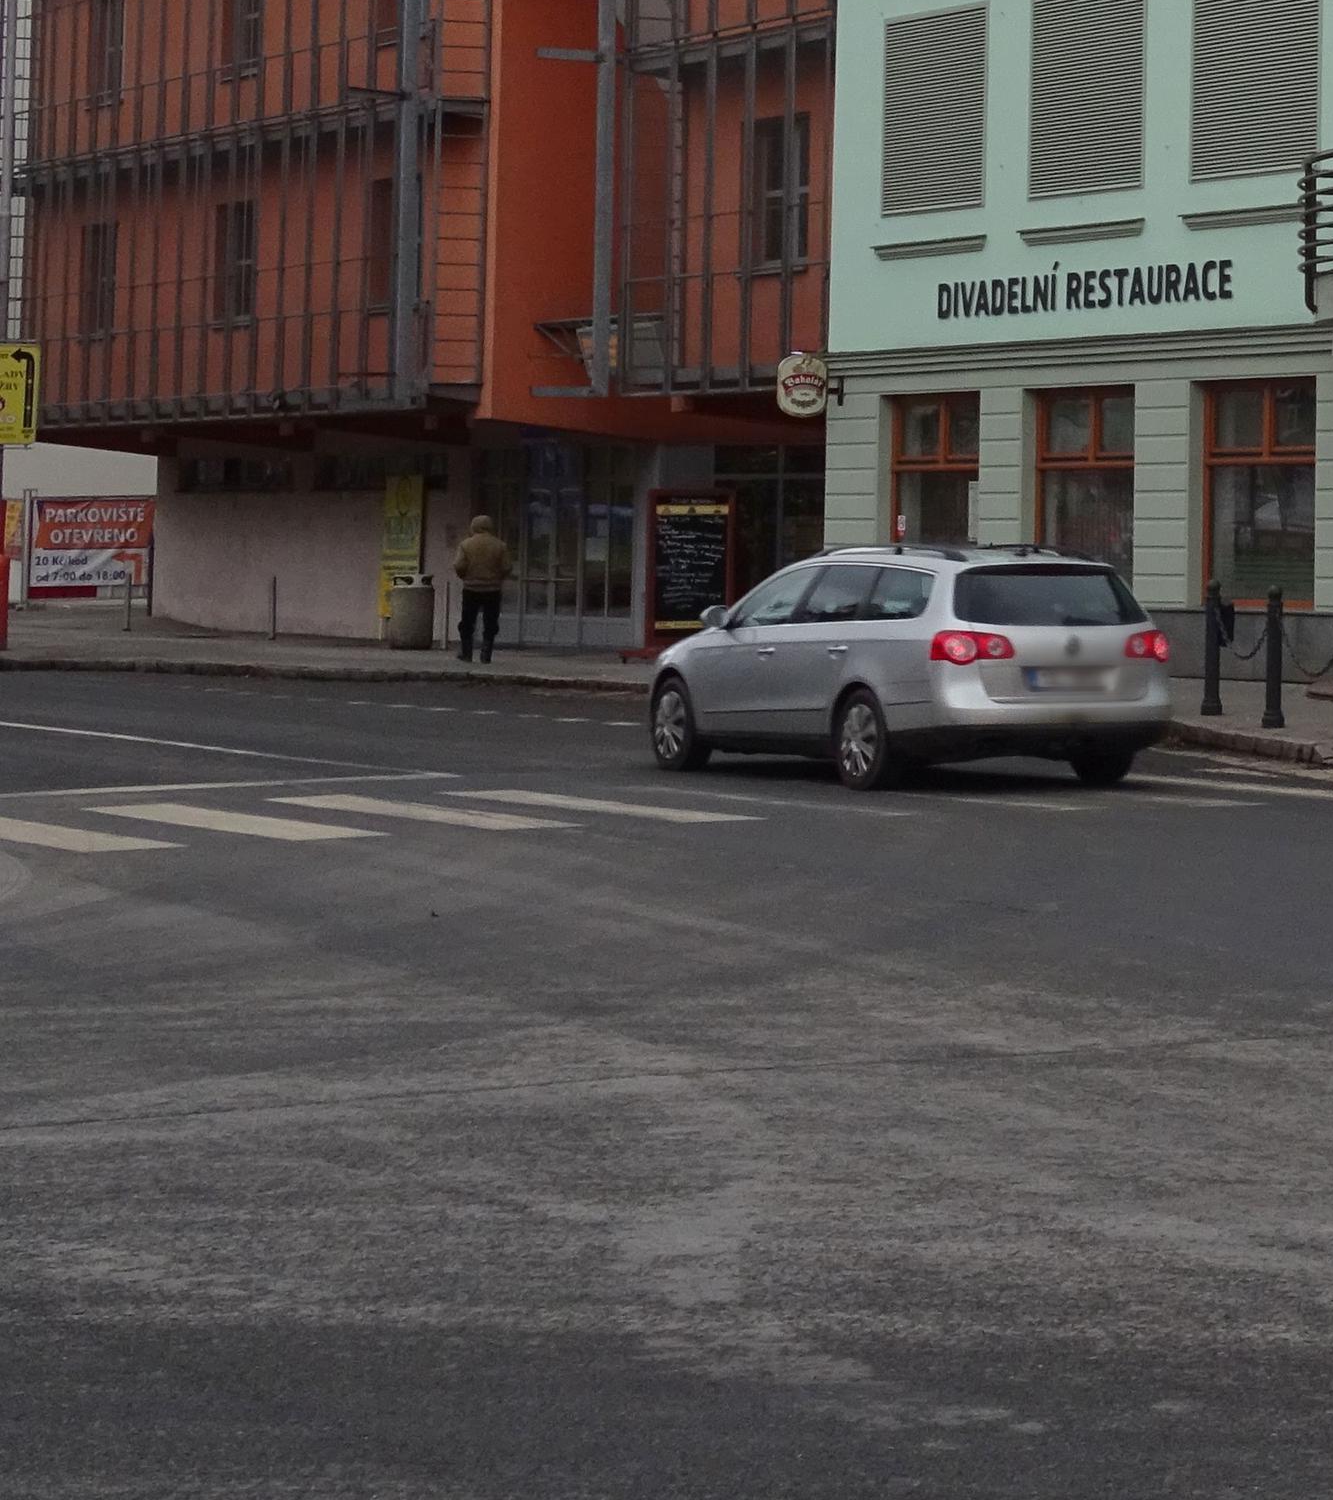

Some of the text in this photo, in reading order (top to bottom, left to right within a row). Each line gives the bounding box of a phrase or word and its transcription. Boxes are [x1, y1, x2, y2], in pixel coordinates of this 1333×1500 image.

[937, 259, 1234, 320] DIVADELNÍ RESTAURACE
[45, 503, 146, 524] PARKOVIŠTĚ
[35, 556, 49, 566] 20
[36, 570, 126, 582] od 7:00 do 18:00
